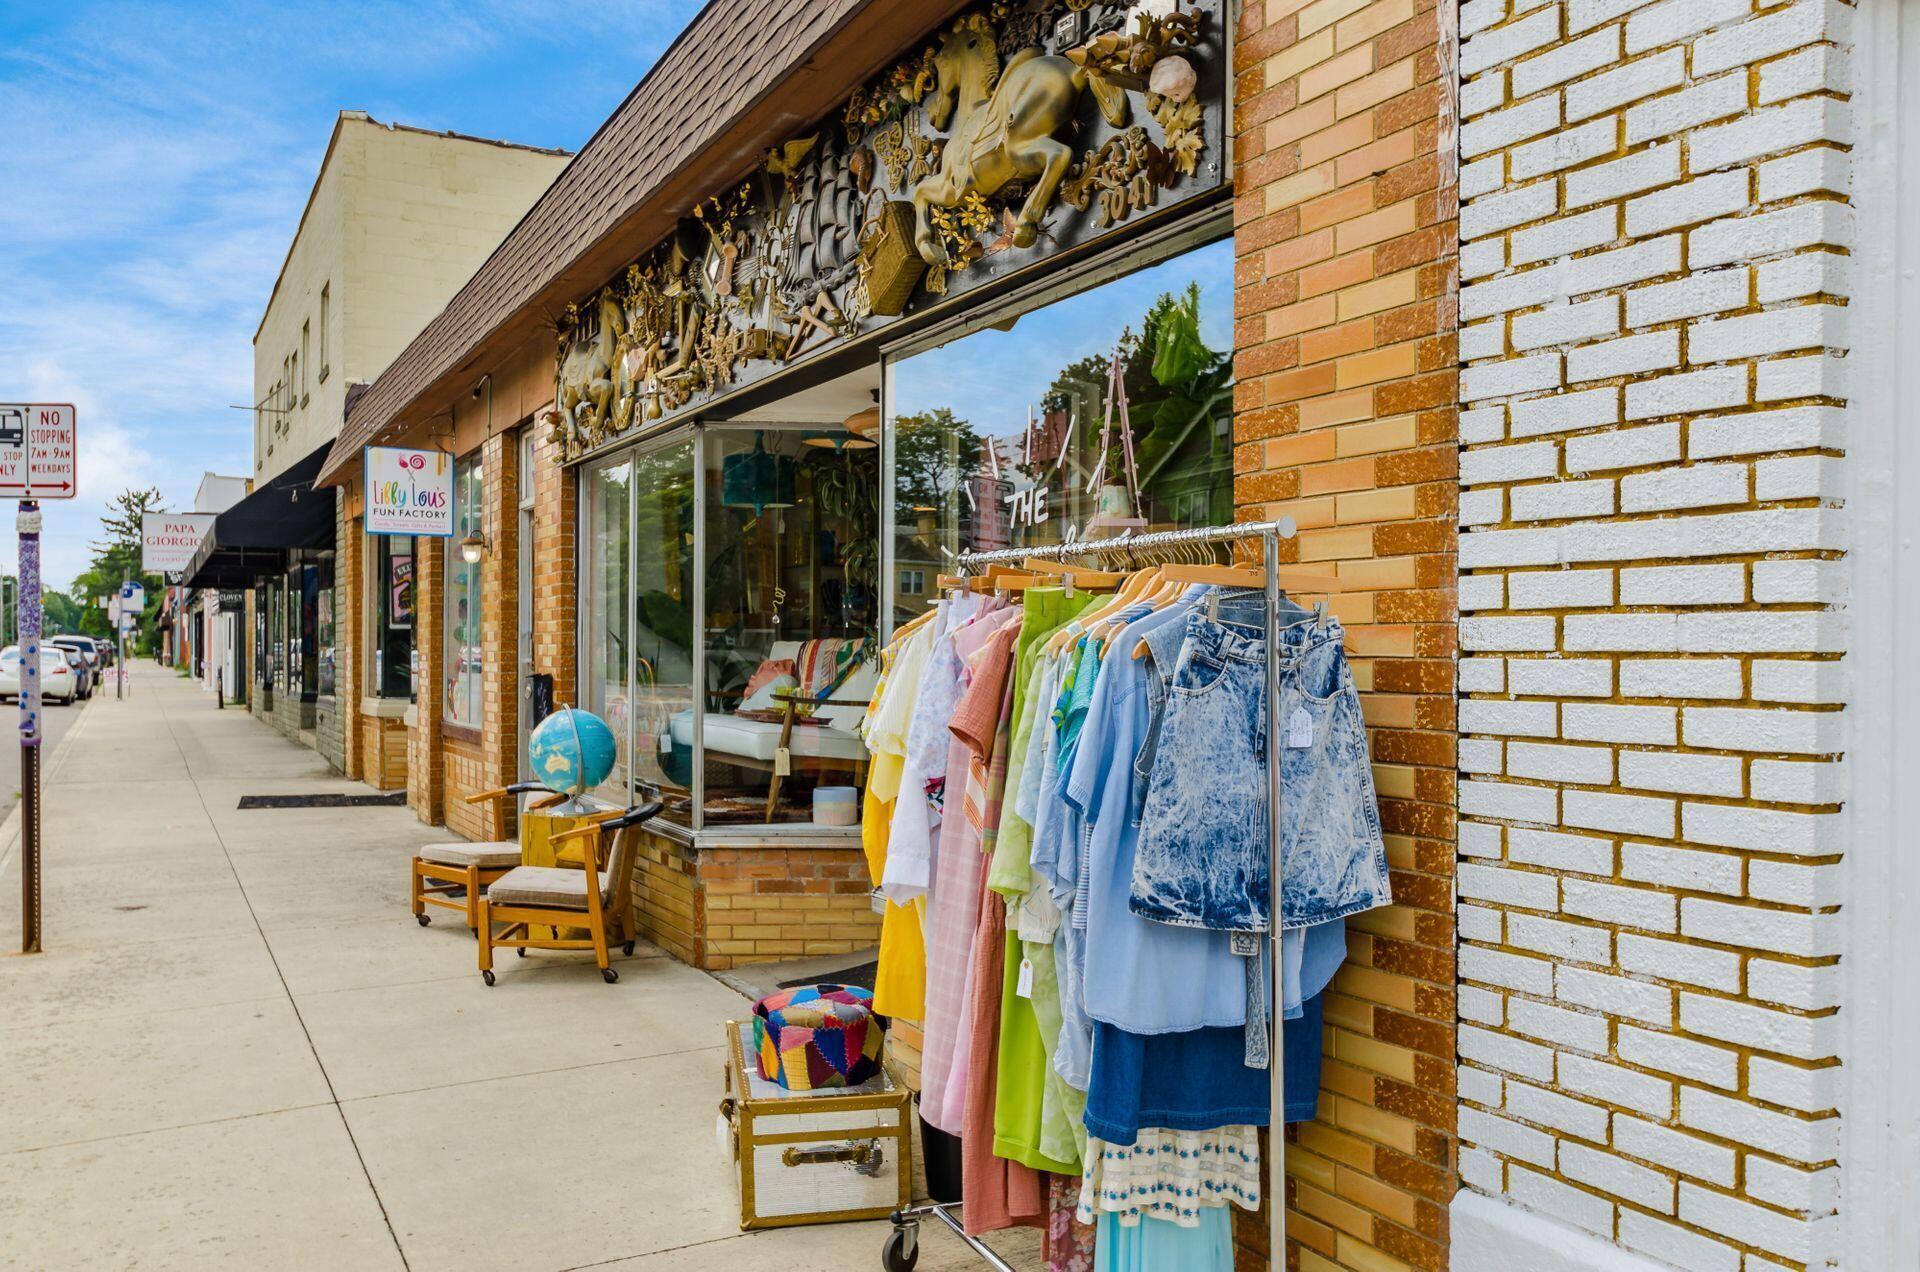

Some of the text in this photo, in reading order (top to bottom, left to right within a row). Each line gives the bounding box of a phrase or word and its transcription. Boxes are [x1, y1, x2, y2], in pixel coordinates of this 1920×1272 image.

[41, 411, 60, 425] NO
[31, 430, 70, 443] STOPPING
[4, 452, 23, 461] STOP
[0, 464, 16, 476] NLY
[31, 464, 70, 473] WEEKDAYS
[374, 480, 406, 508] Libby
[373, 508, 447, 519] FUN FACTORY
[1004, 486, 1049, 530] THE
[165, 523, 195, 533] PAPA
